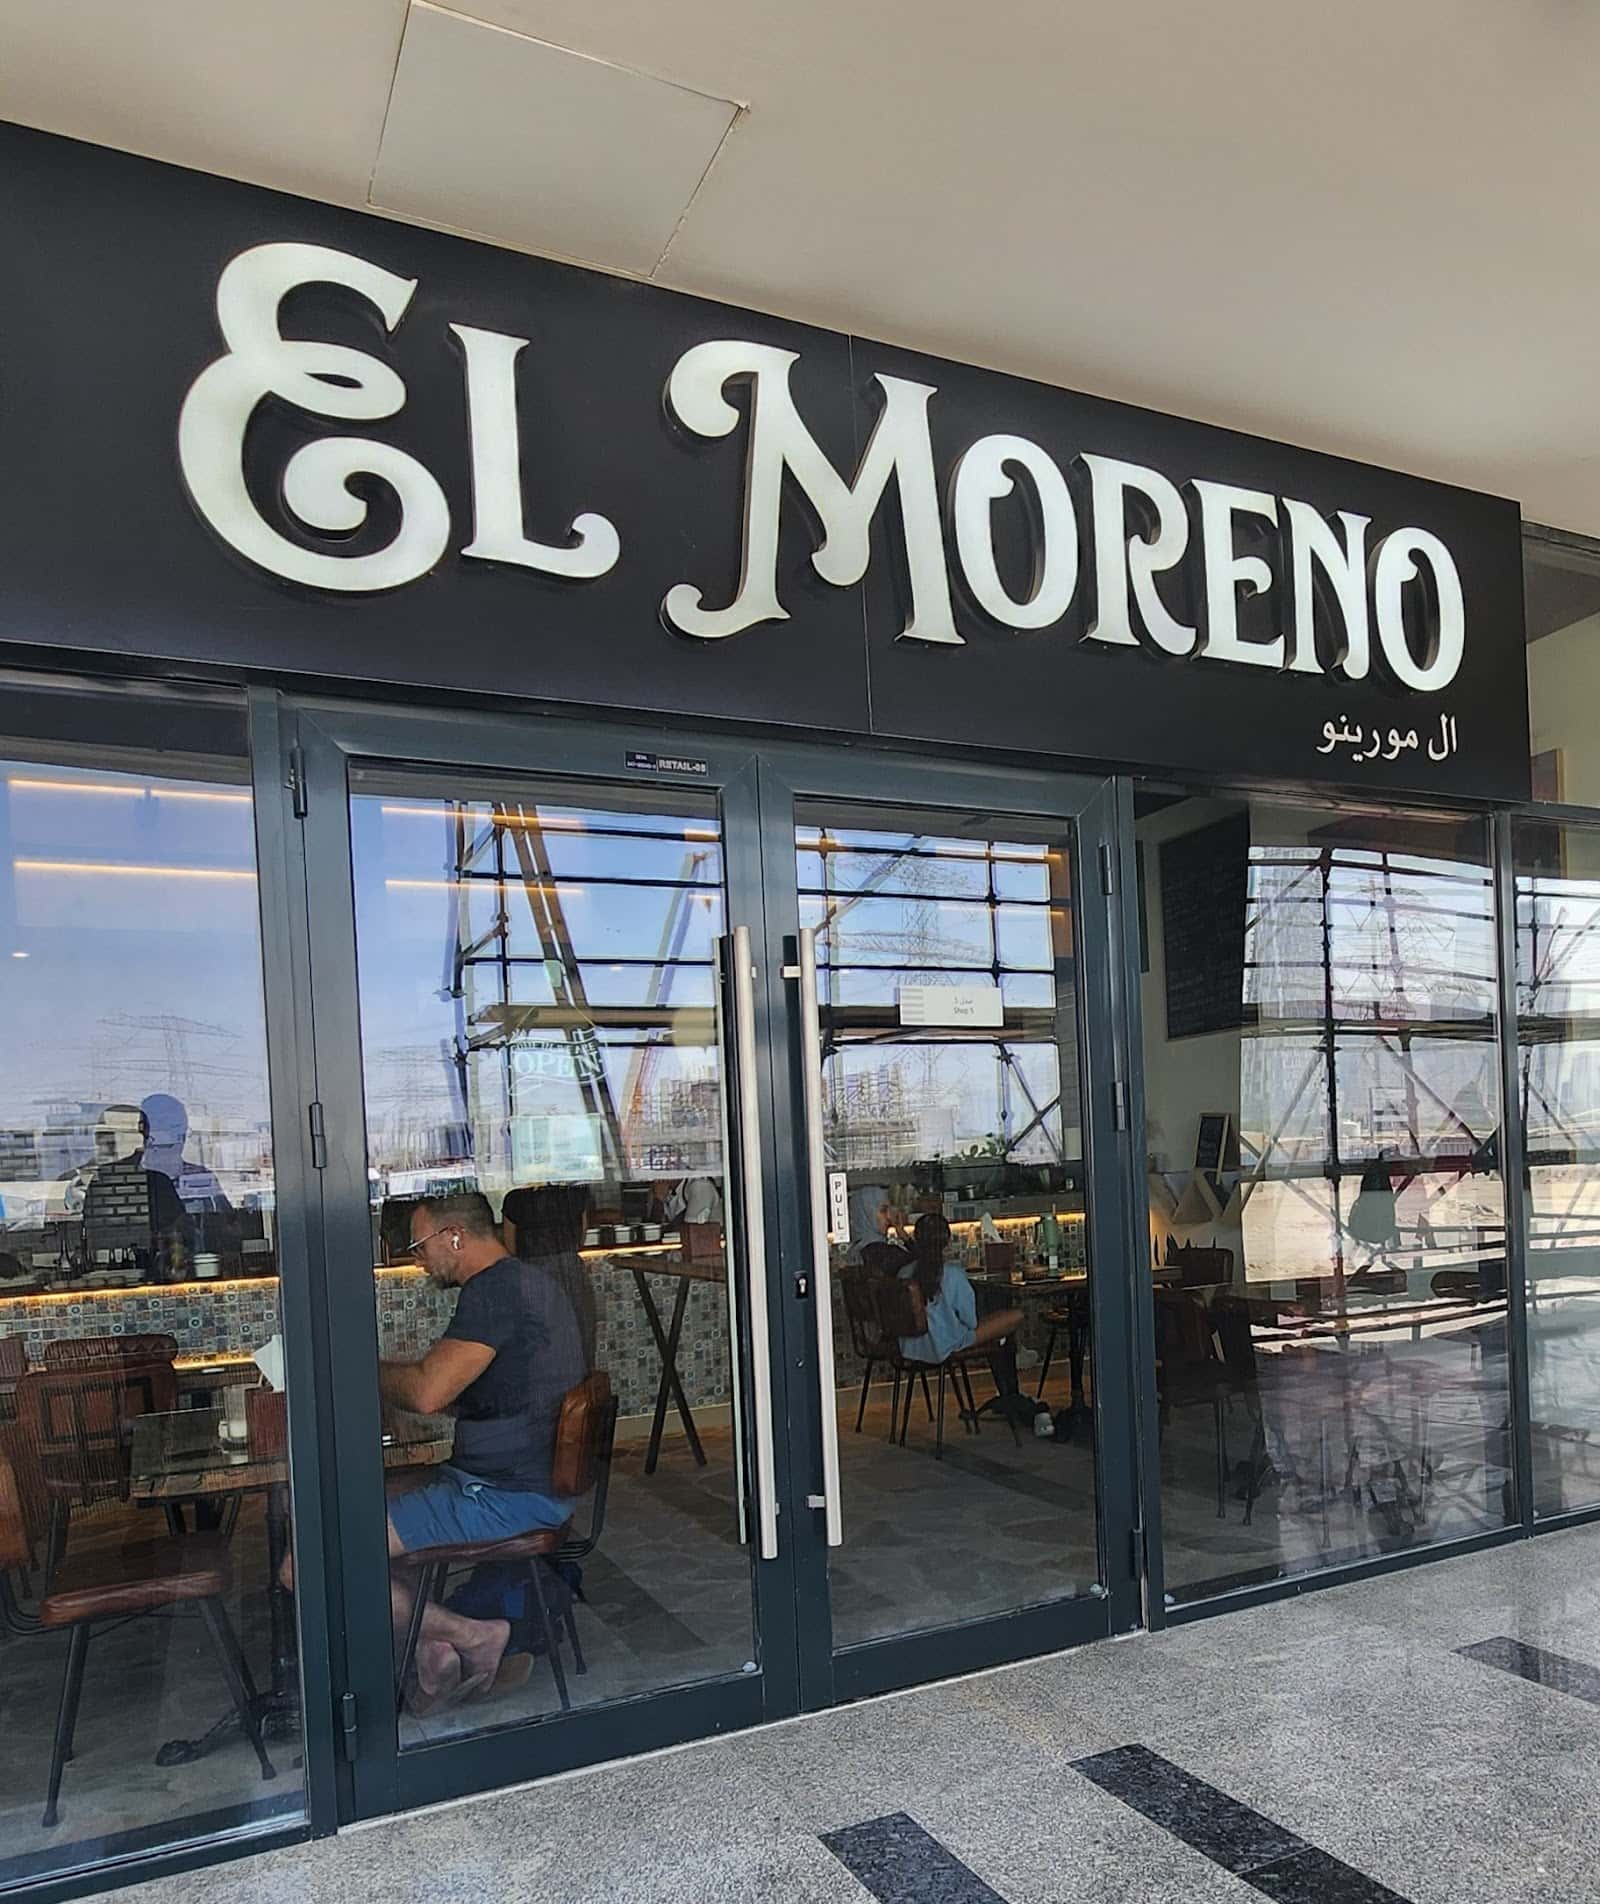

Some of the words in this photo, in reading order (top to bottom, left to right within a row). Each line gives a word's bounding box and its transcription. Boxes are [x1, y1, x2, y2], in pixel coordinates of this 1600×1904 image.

[178, 242, 621, 591] EL
[662, 339, 1465, 692] MORENO
[1315, 713, 1420, 763] مورينو
[1427, 712, 1458, 761] ال
[515, 1051, 601, 1077] OPEN
[834, 1180, 844, 1230] PULL
